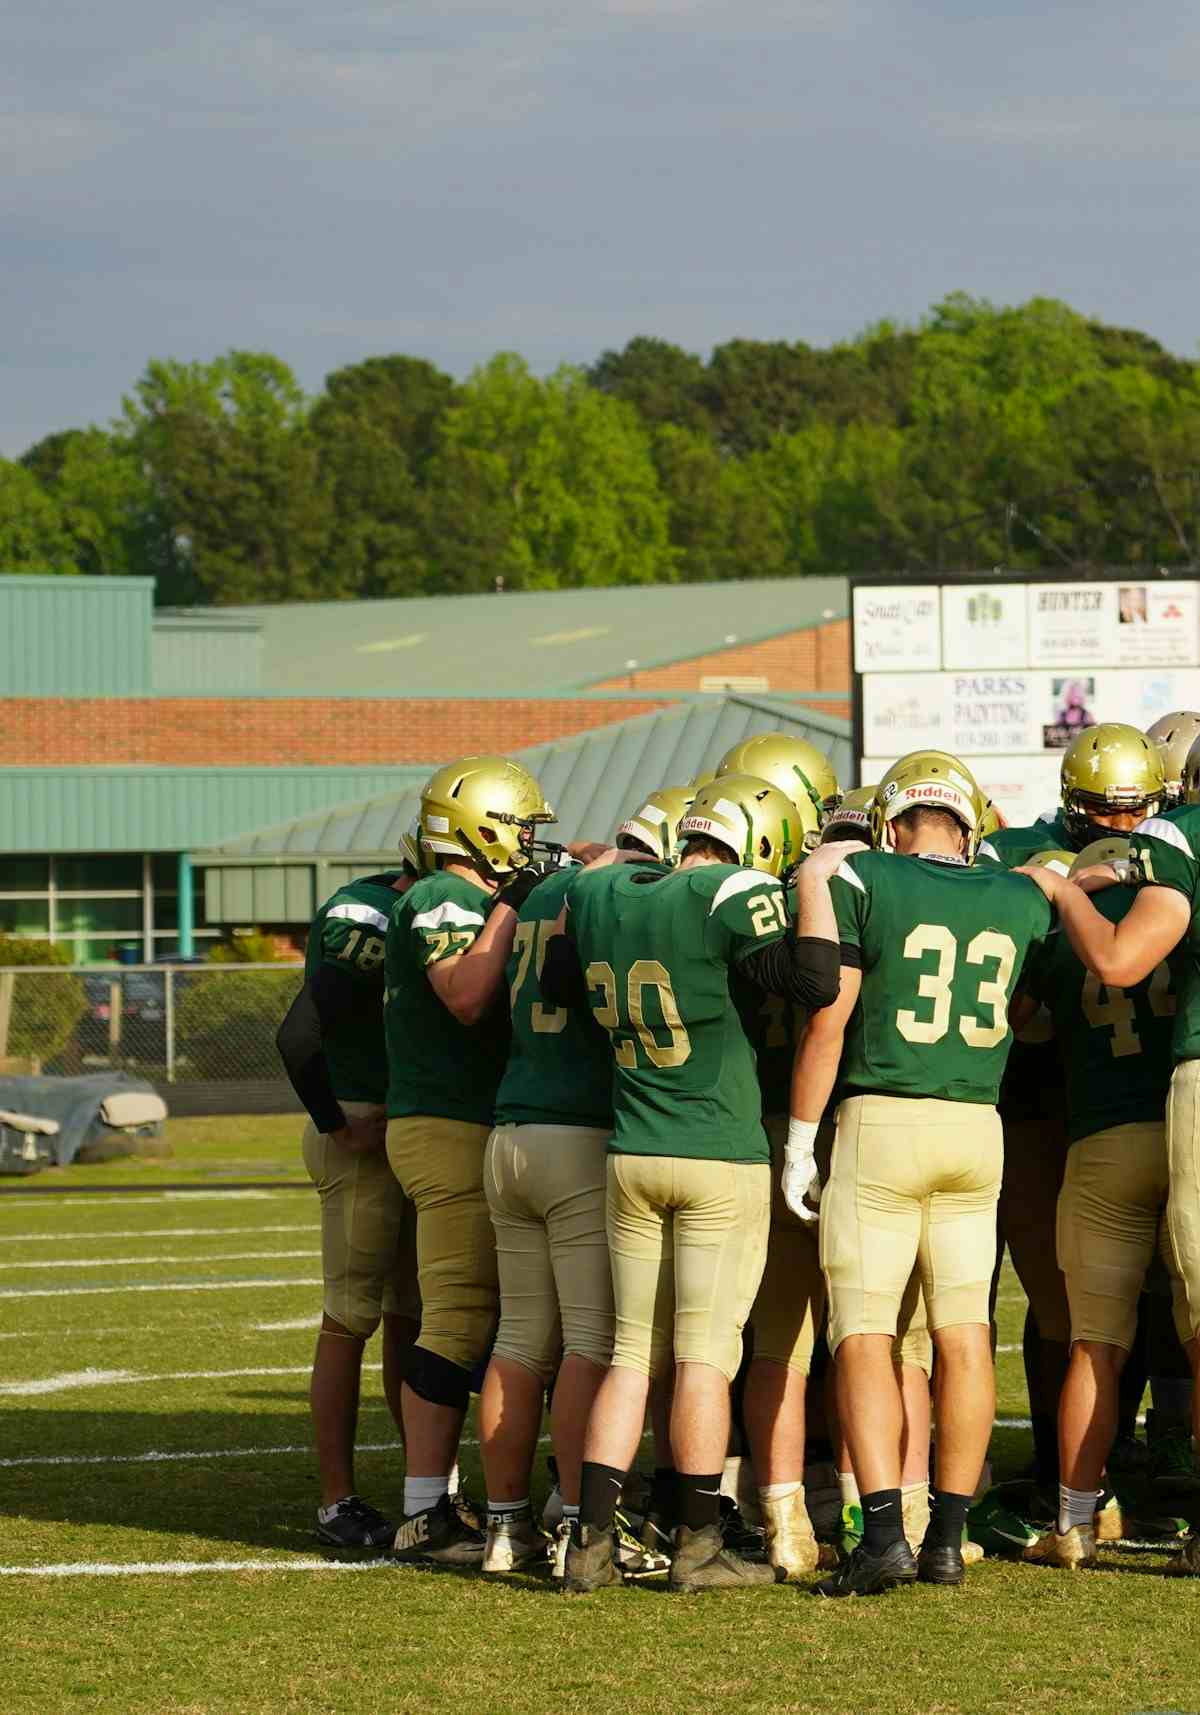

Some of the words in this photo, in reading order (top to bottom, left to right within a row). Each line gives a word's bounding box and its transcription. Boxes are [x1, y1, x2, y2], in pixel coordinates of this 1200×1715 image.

[954, 678, 1025, 696] PARKS
[905, 786, 961, 804] Riddell
[896, 923, 1017, 1048] 33
